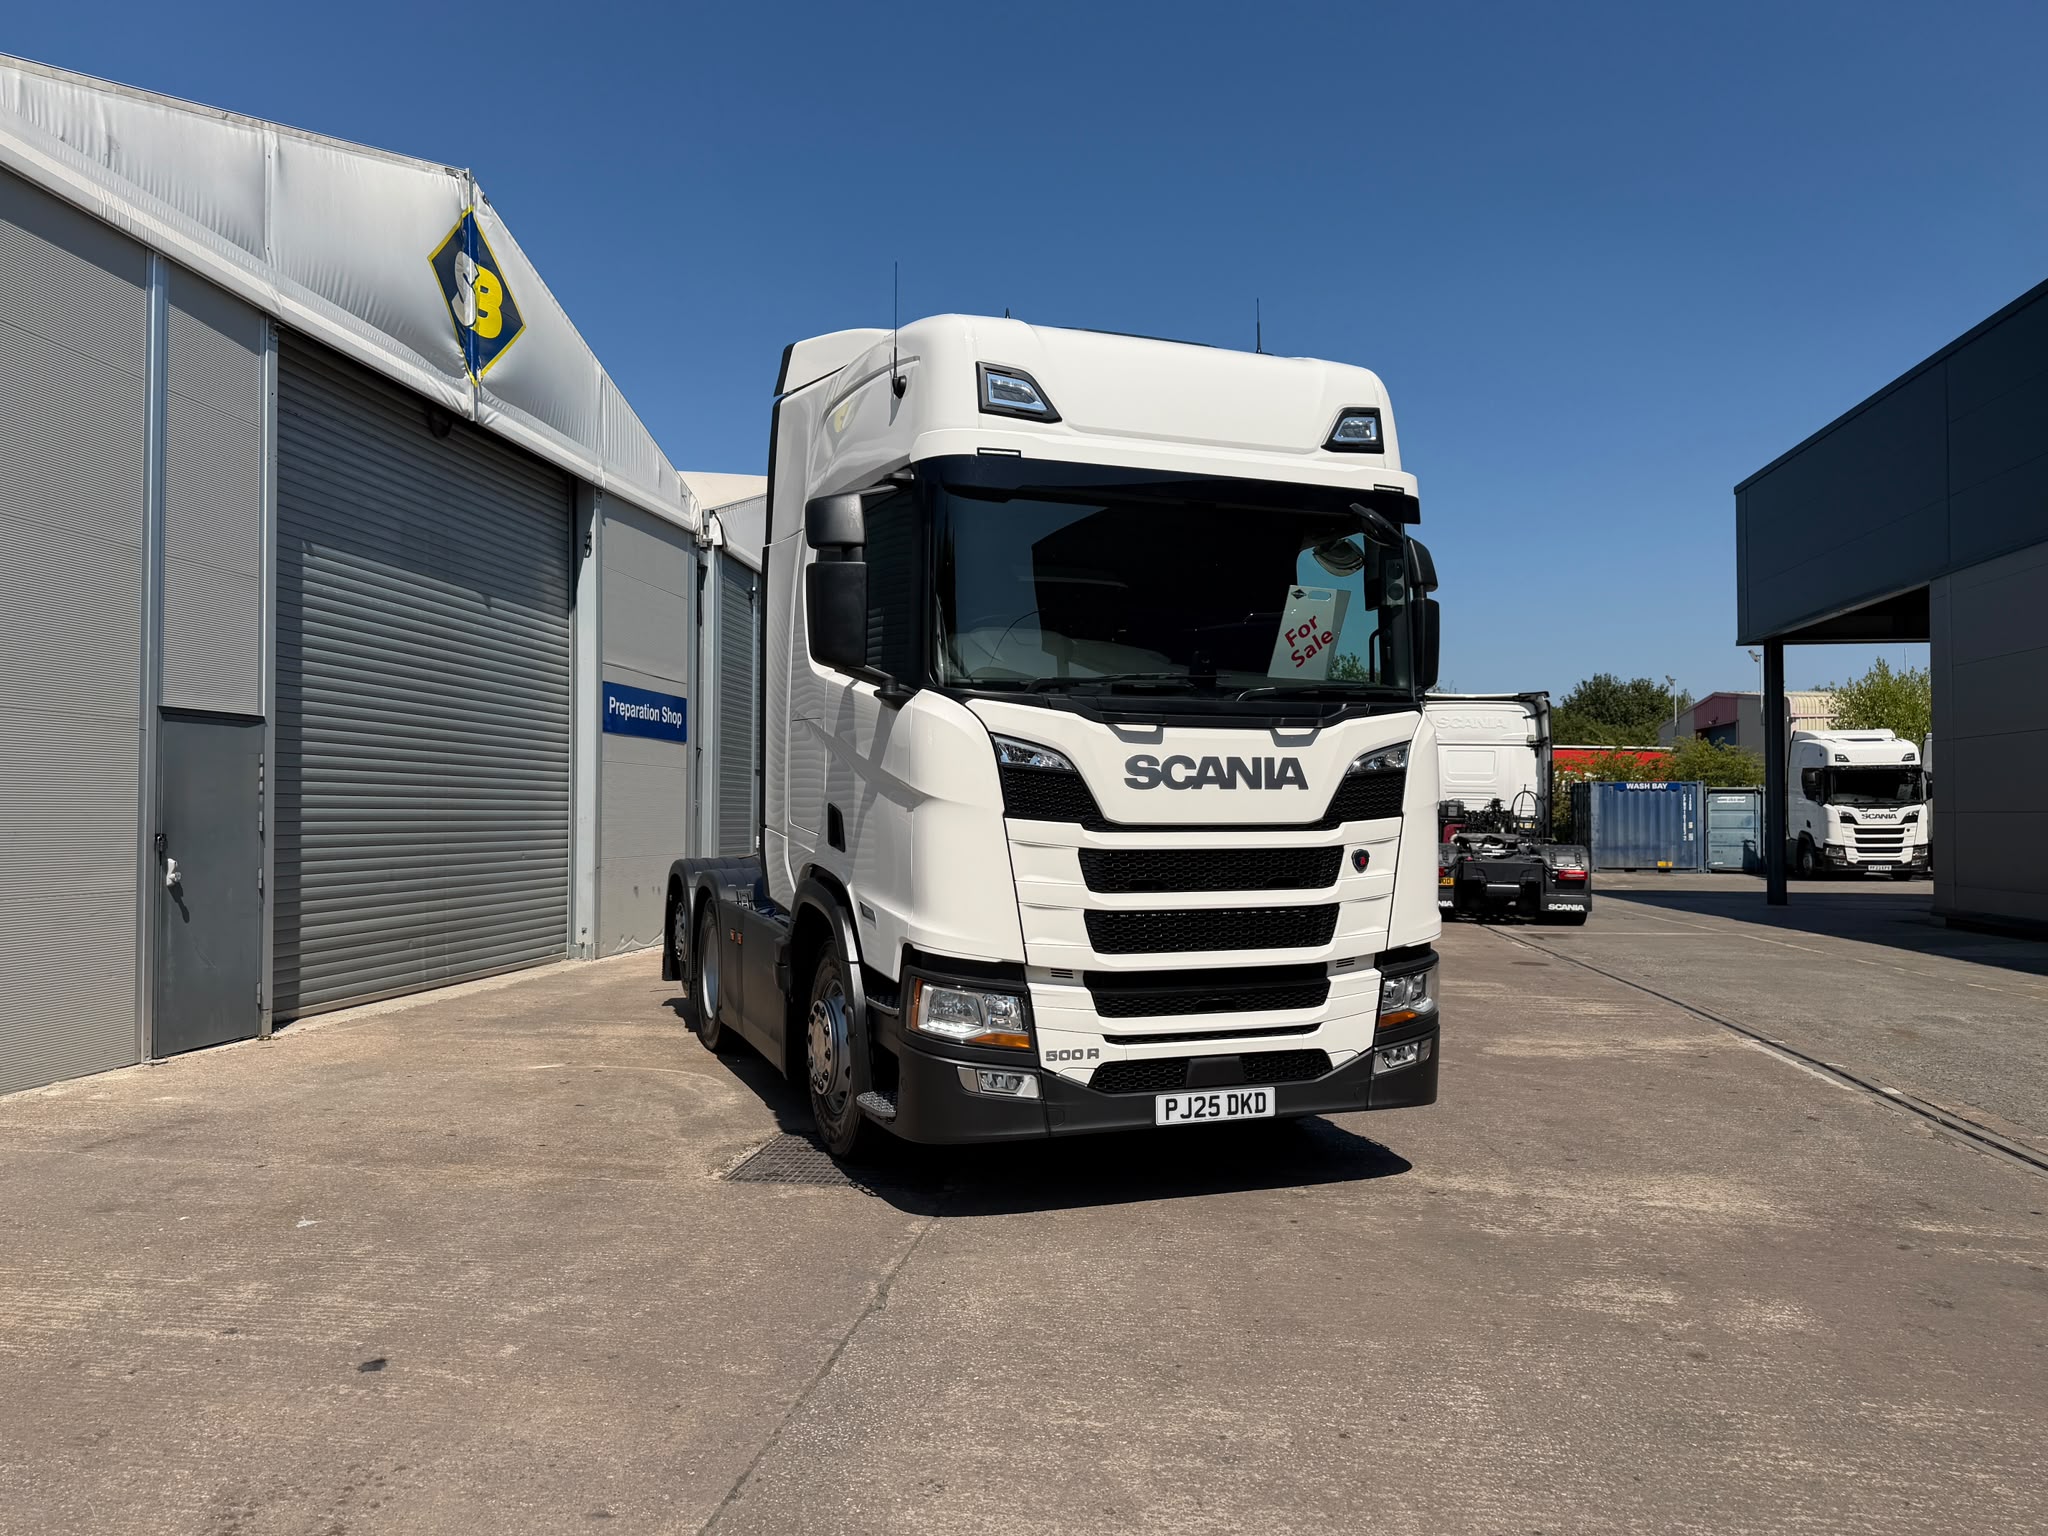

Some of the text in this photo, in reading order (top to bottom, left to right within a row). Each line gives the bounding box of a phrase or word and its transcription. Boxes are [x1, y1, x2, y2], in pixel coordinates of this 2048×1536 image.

[1284, 615, 1318, 648] For
[1291, 631, 1334, 668] Sale
[609, 696, 682, 729] Preparation Shop
[1436, 716, 1508, 729] SCANIA
[1124, 754, 1309, 790] SCANIA
[1548, 903, 1585, 911] SCANIA
[1045, 1048, 1100, 1062] 500 R
[1165, 1092, 1267, 1121] PJ25 DKD
